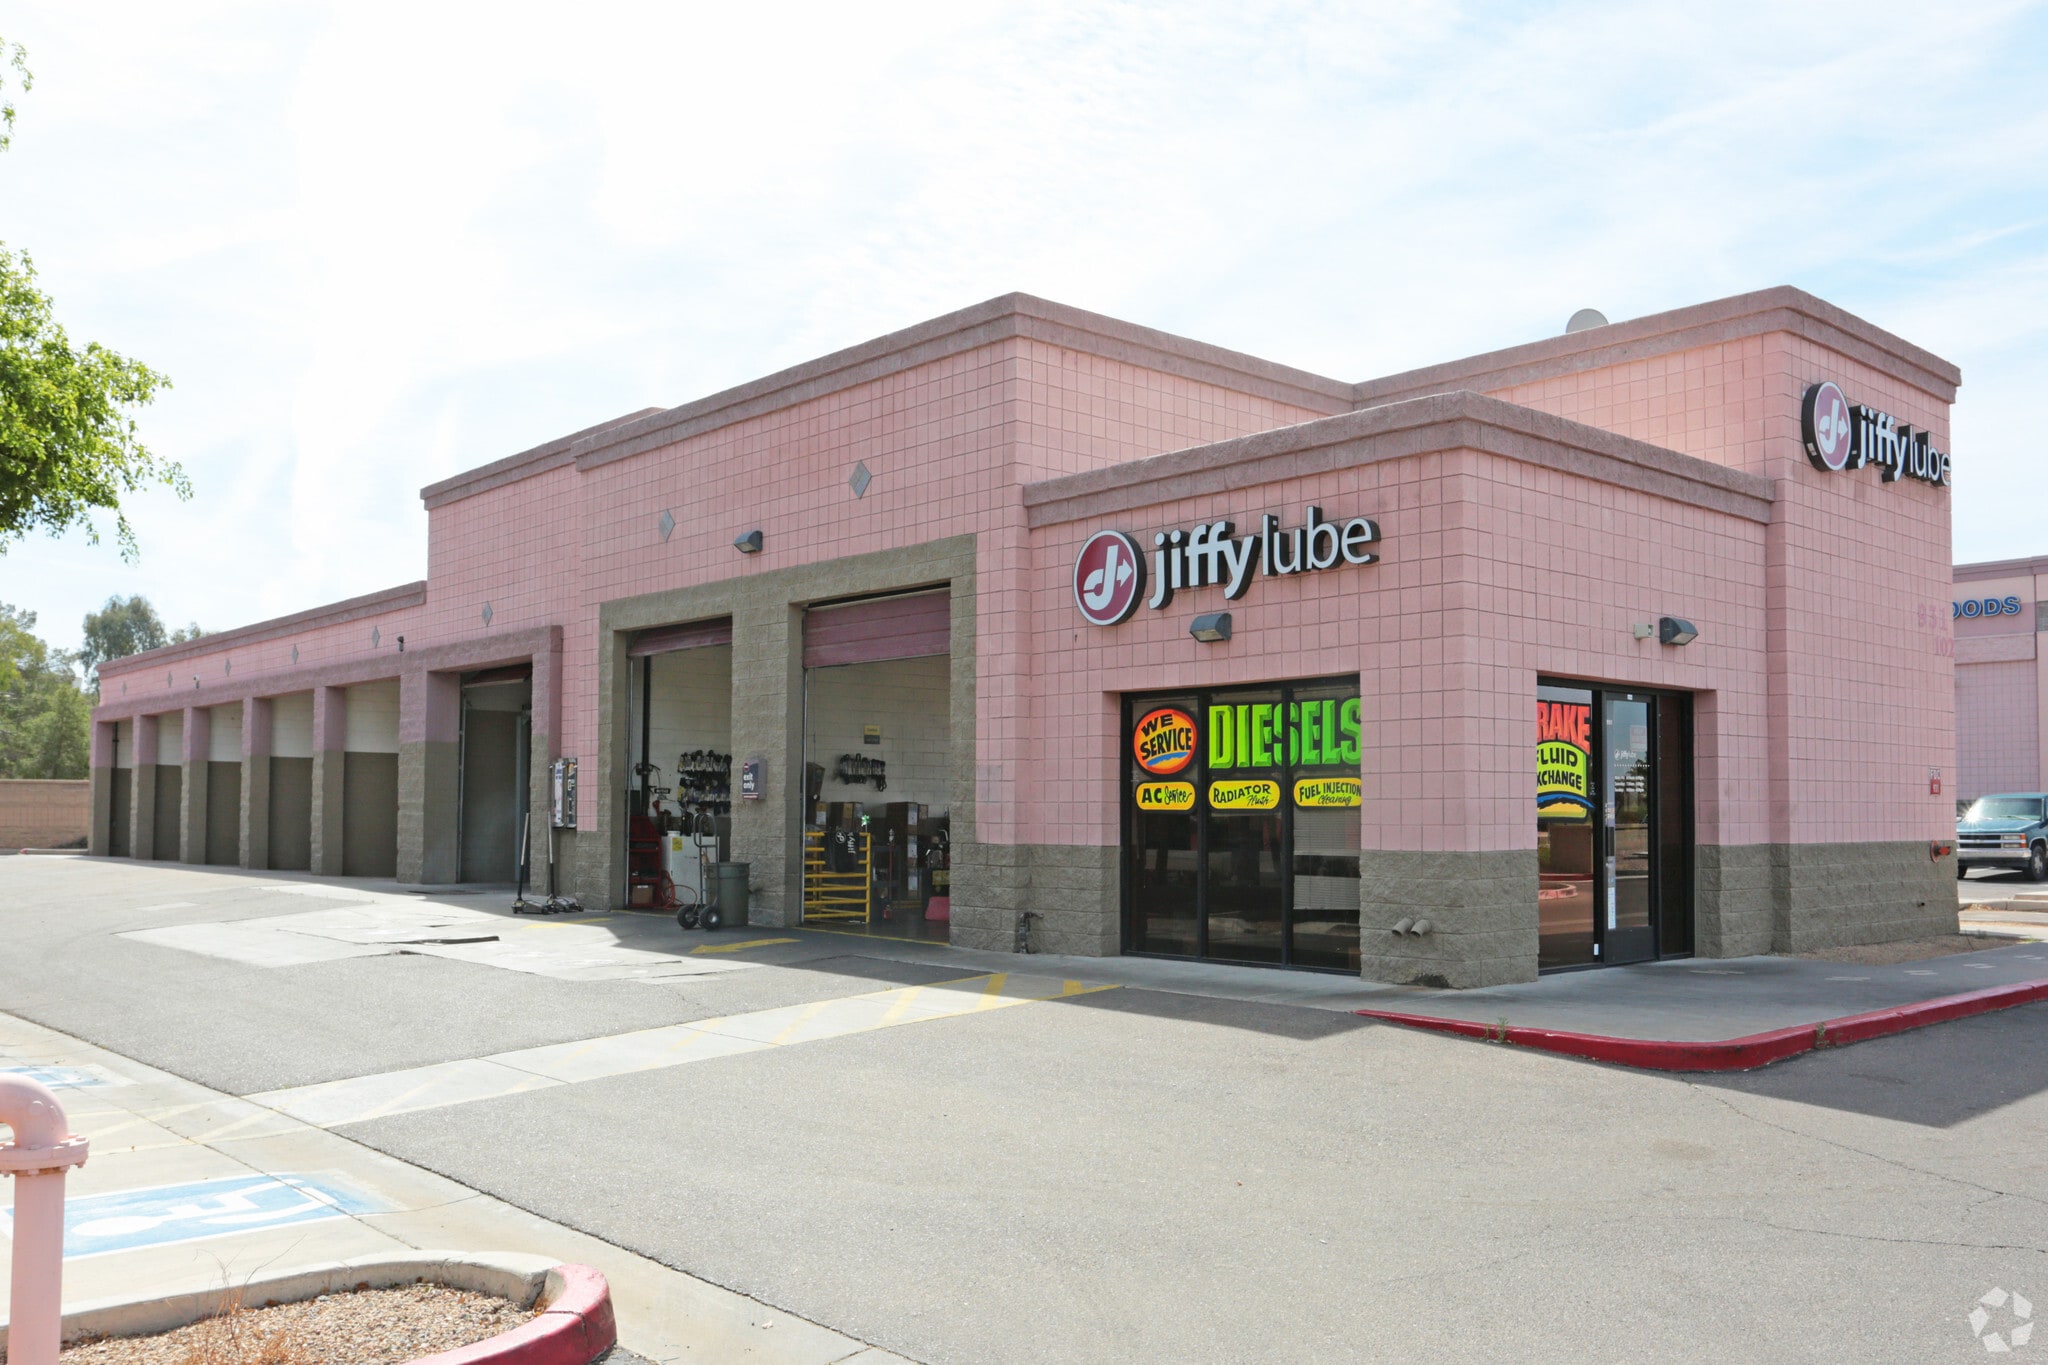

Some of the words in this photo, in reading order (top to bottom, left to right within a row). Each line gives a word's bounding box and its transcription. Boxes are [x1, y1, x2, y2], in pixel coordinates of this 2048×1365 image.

[1149, 521, 1257, 610] jiffy
[1263, 506, 1377, 576] lube
[1141, 713, 1174, 737] WE
[1208, 697, 1361, 769] DIESELS
[1140, 727, 1192, 761] SERVICE
[1537, 747, 1579, 767] LUID
[743, 772, 754, 781] exit
[743, 781, 755, 791] only
[1141, 787, 1163, 804] AC
[1213, 783, 1271, 804] RADIATOR
[1299, 784, 1321, 802] FUEL
[1323, 781, 1361, 797] INJECTION
